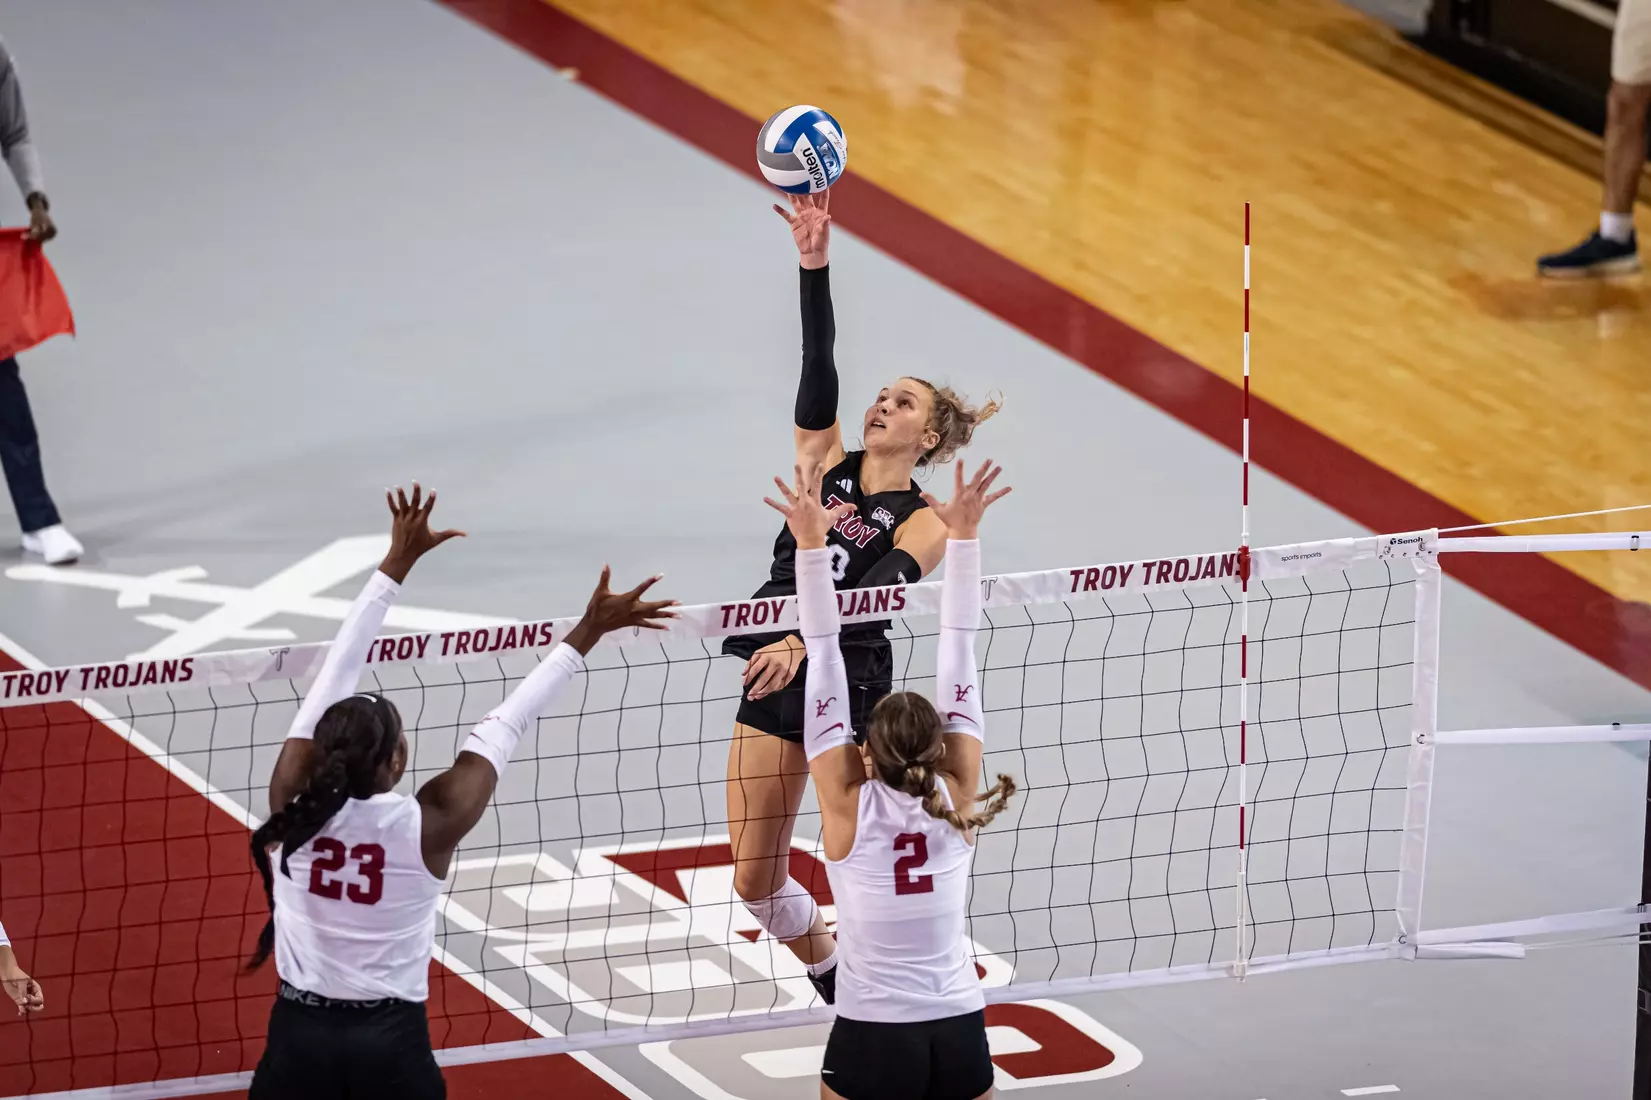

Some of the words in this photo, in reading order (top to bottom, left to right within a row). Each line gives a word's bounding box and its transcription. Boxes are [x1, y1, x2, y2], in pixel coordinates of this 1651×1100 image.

[802, 147, 826, 189] molten
[825, 493, 880, 549] TROY
[1397, 536, 1423, 545] Senoh
[1281, 553, 1299, 562] sports
[1300, 552, 1322, 561] imports
[1070, 564, 1134, 593] TROY
[720, 599, 787, 629] TROY
[366, 634, 431, 664] TROY
[440, 622, 553, 657] TROJANS
[3, 669, 69, 699] TROY
[80, 657, 194, 691] TROJANS
[308, 836, 385, 906] 23
[893, 832, 934, 896] 2
[281, 983, 320, 1006] NIKE
